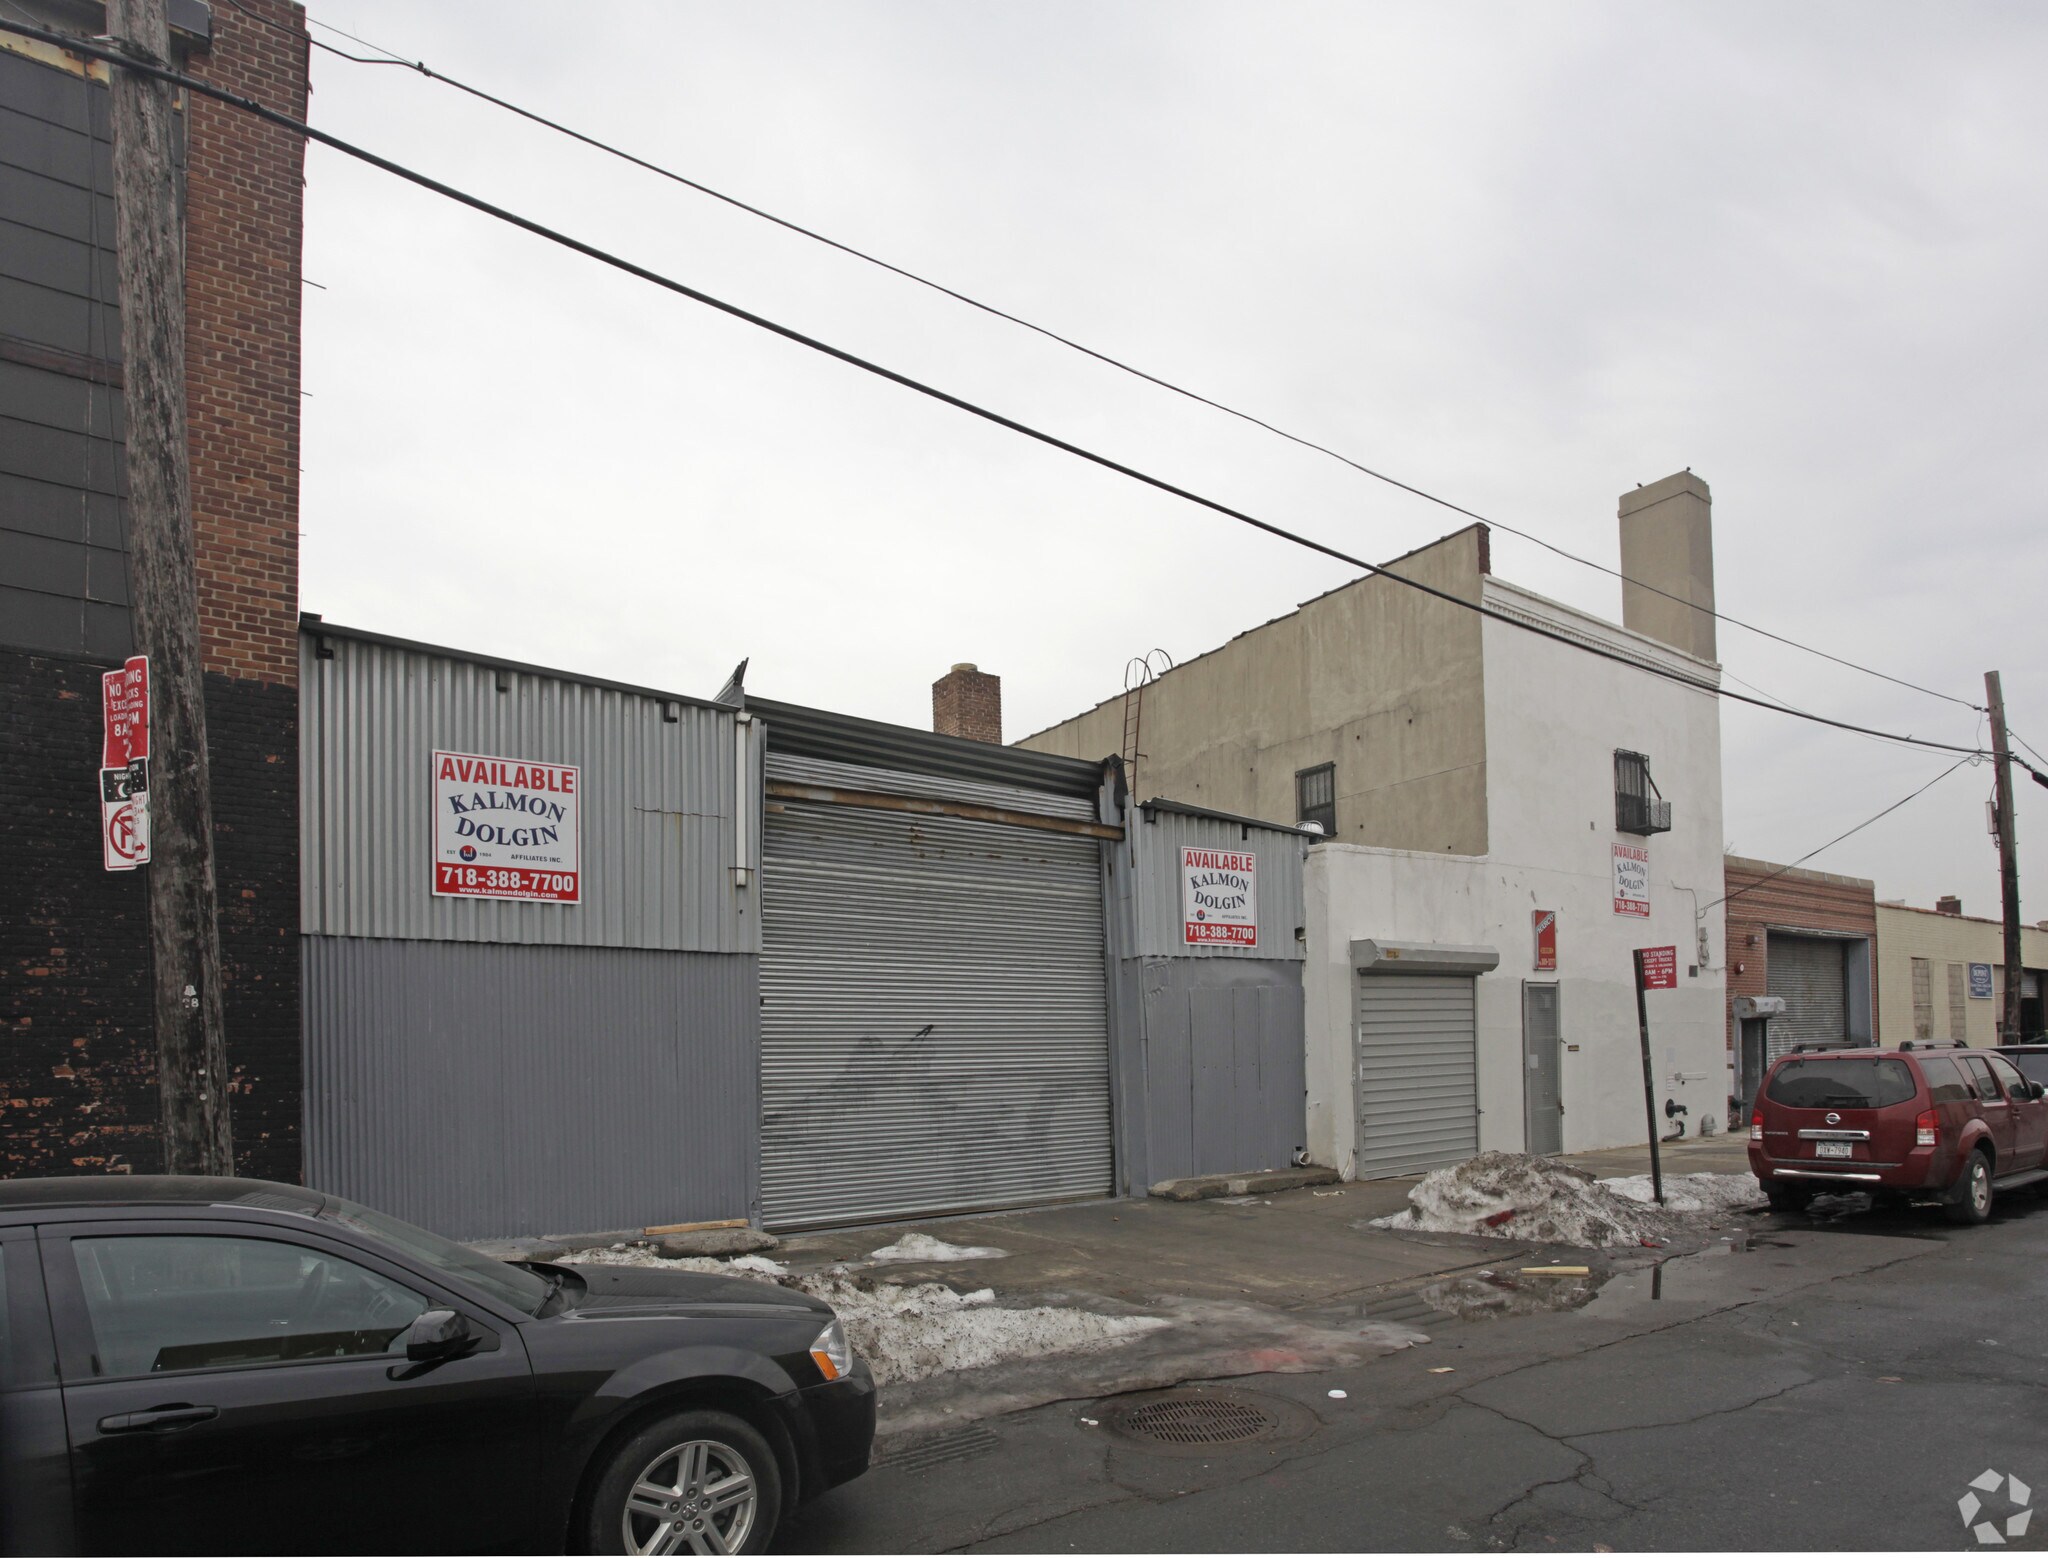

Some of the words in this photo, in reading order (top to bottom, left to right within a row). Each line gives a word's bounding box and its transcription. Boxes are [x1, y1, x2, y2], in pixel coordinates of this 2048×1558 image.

[109, 683, 122, 697] NO
[439, 757, 574, 794] AVAILABLE
[448, 791, 567, 823] KALMON
[454, 816, 559, 846] DOLGIN
[510, 854, 548, 863] AFFILIATES
[1185, 851, 1253, 872] AVAILABLE
[1614, 845, 1648, 863] AVAILABLE
[1616, 861, 1646, 877] KALMON
[441, 866, 574, 893] 718-388-7700
[1190, 872, 1249, 892] KALMON
[1618, 875, 1645, 890] DOLGIN
[458, 887, 558, 899] www.kalmondolgin.com
[1194, 891, 1246, 910] DOLGIN
[1188, 924, 1254, 940] 718-388-7700
[1650, 950, 1674, 958] STANDING
